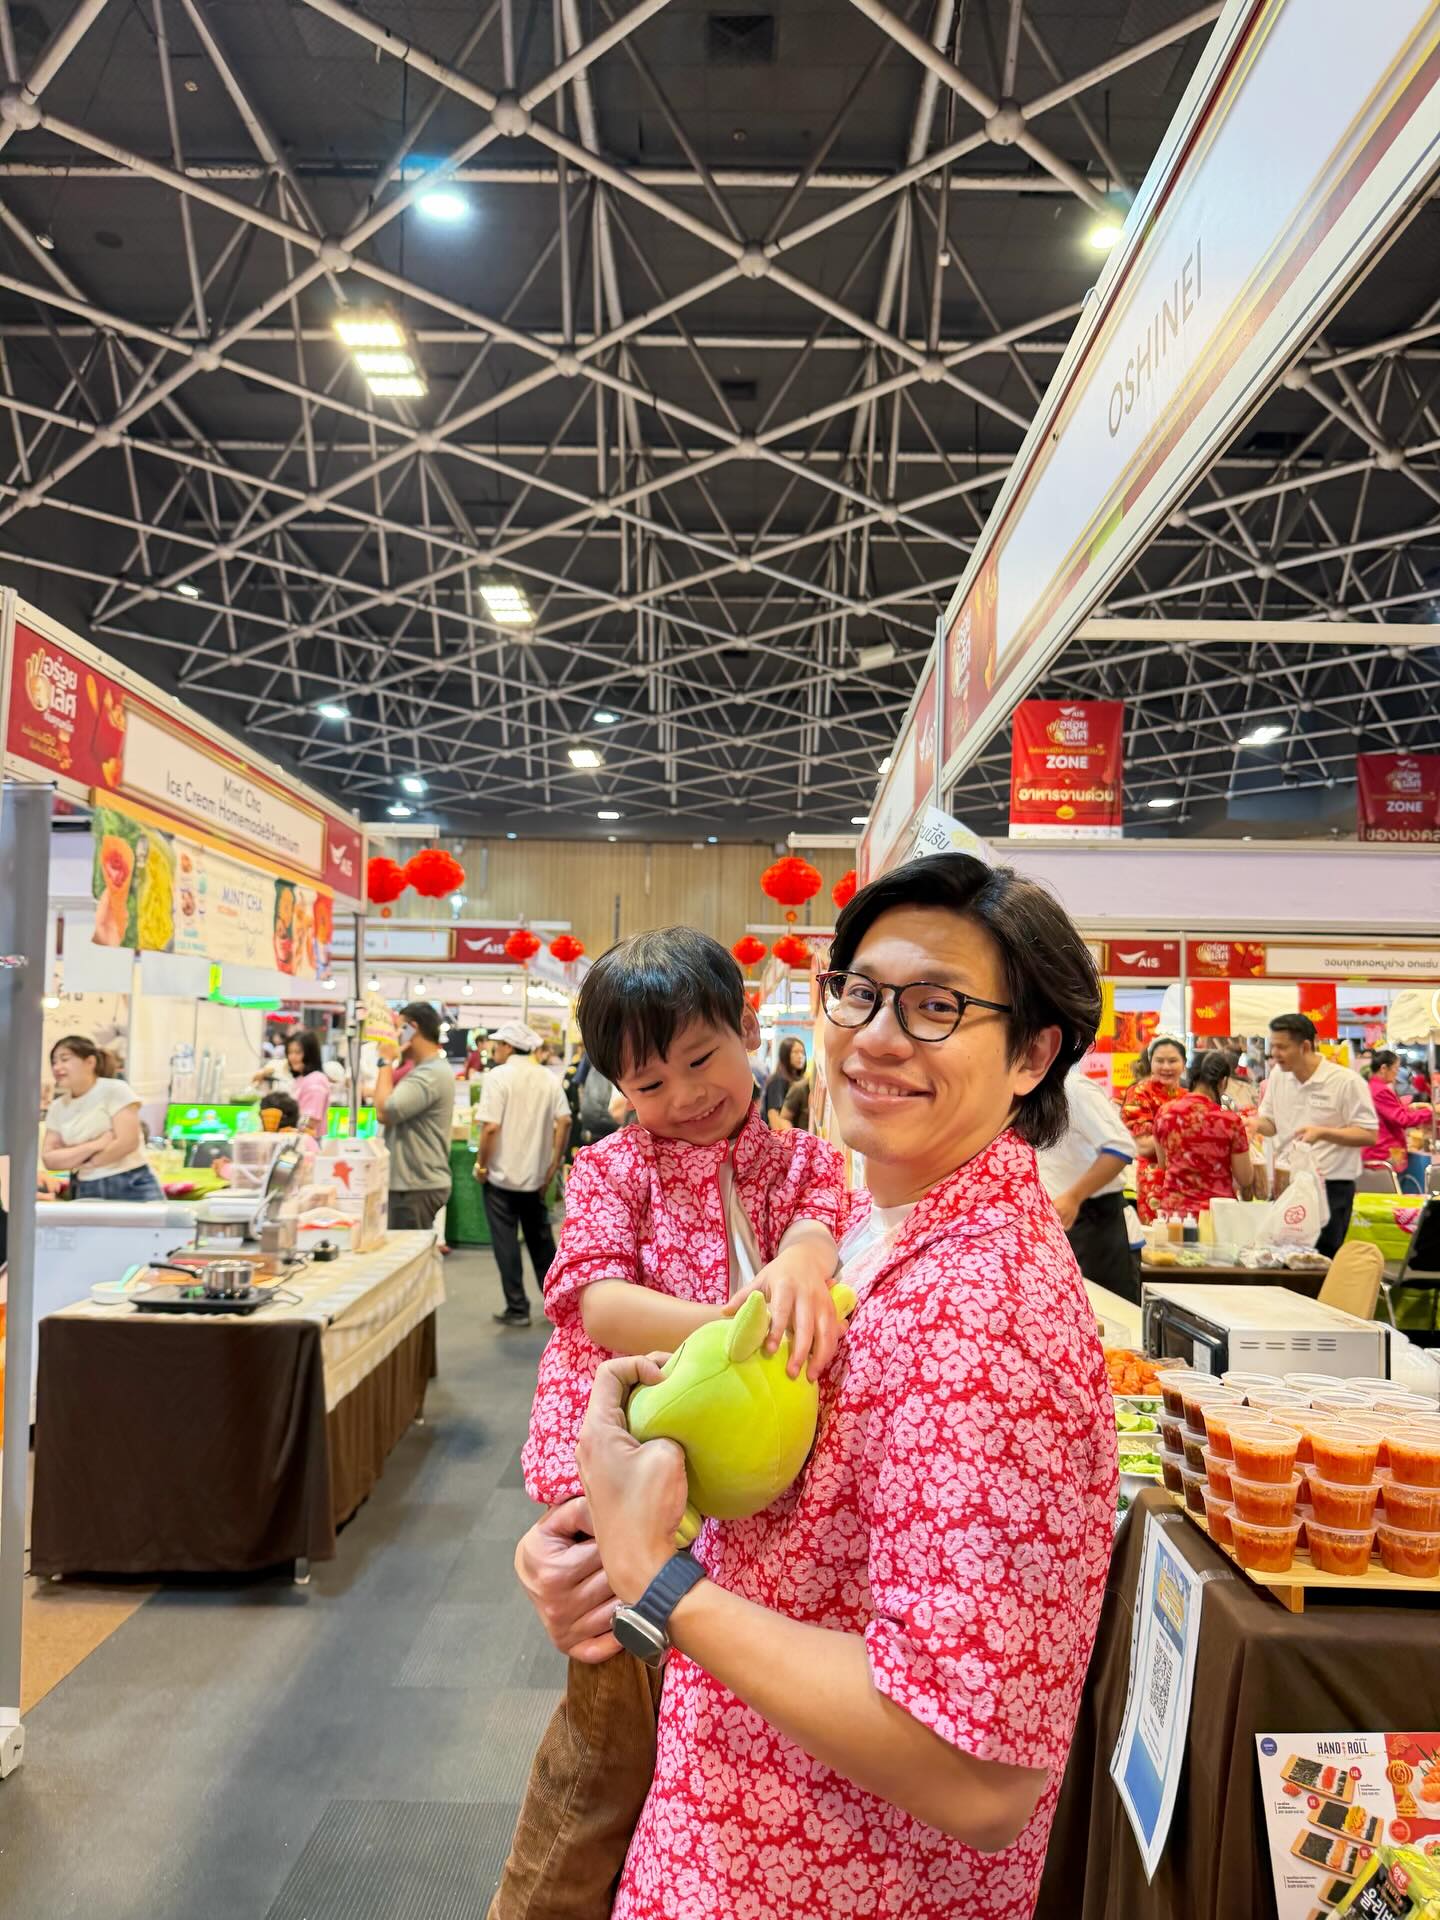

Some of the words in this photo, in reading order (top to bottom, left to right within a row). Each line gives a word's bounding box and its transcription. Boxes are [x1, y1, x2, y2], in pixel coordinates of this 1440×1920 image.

[1108, 237, 1202, 438] OSHINEI
[42, 655, 78, 690] อร่อย
[51, 681, 77, 719] เลิศ
[1059, 718, 1088, 731] อร่อย
[1046, 755, 1089, 769] ZONE
[166, 770, 182, 799] Ice
[184, 781, 217, 816] Cream
[1018, 785, 1114, 802] อาหารจานด่วน
[1386, 801, 1424, 813] ZONE
[483, 943, 505, 955] AIS
[1138, 957, 1160, 969] AIS
[1317, 1741, 1341, 1755] HAND
[1347, 1741, 1369, 1755] ROLL
